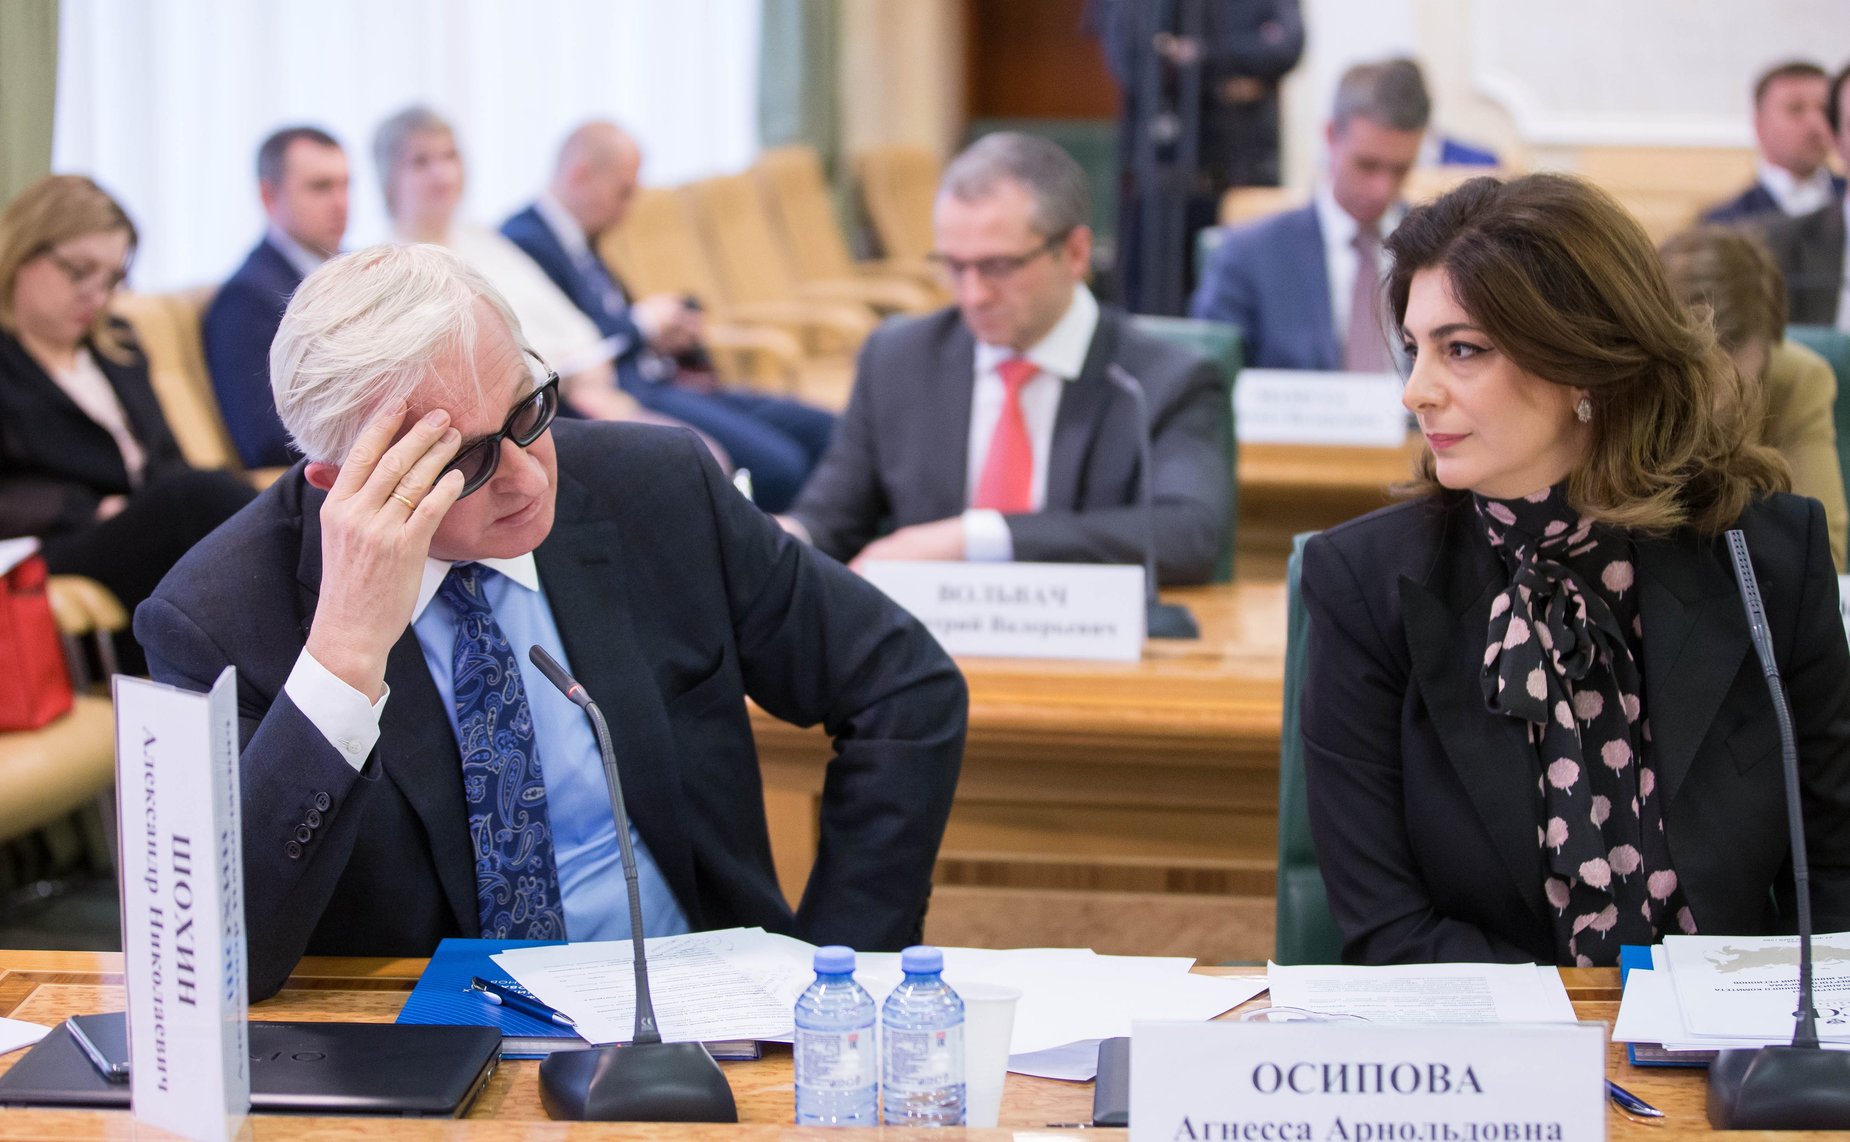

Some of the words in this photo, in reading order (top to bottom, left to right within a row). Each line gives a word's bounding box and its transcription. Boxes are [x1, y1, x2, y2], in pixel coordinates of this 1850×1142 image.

[142, 726, 158, 893] Александр
[149, 905, 168, 1091] Николаевич
[171, 833, 197, 1006] ШОХИН
[1174, 1114, 1314, 1141] Агнесса
[1325, 1114, 1563, 1142] Арнольдовна
[1251, 1061, 1485, 1095] ОСИПОВА
